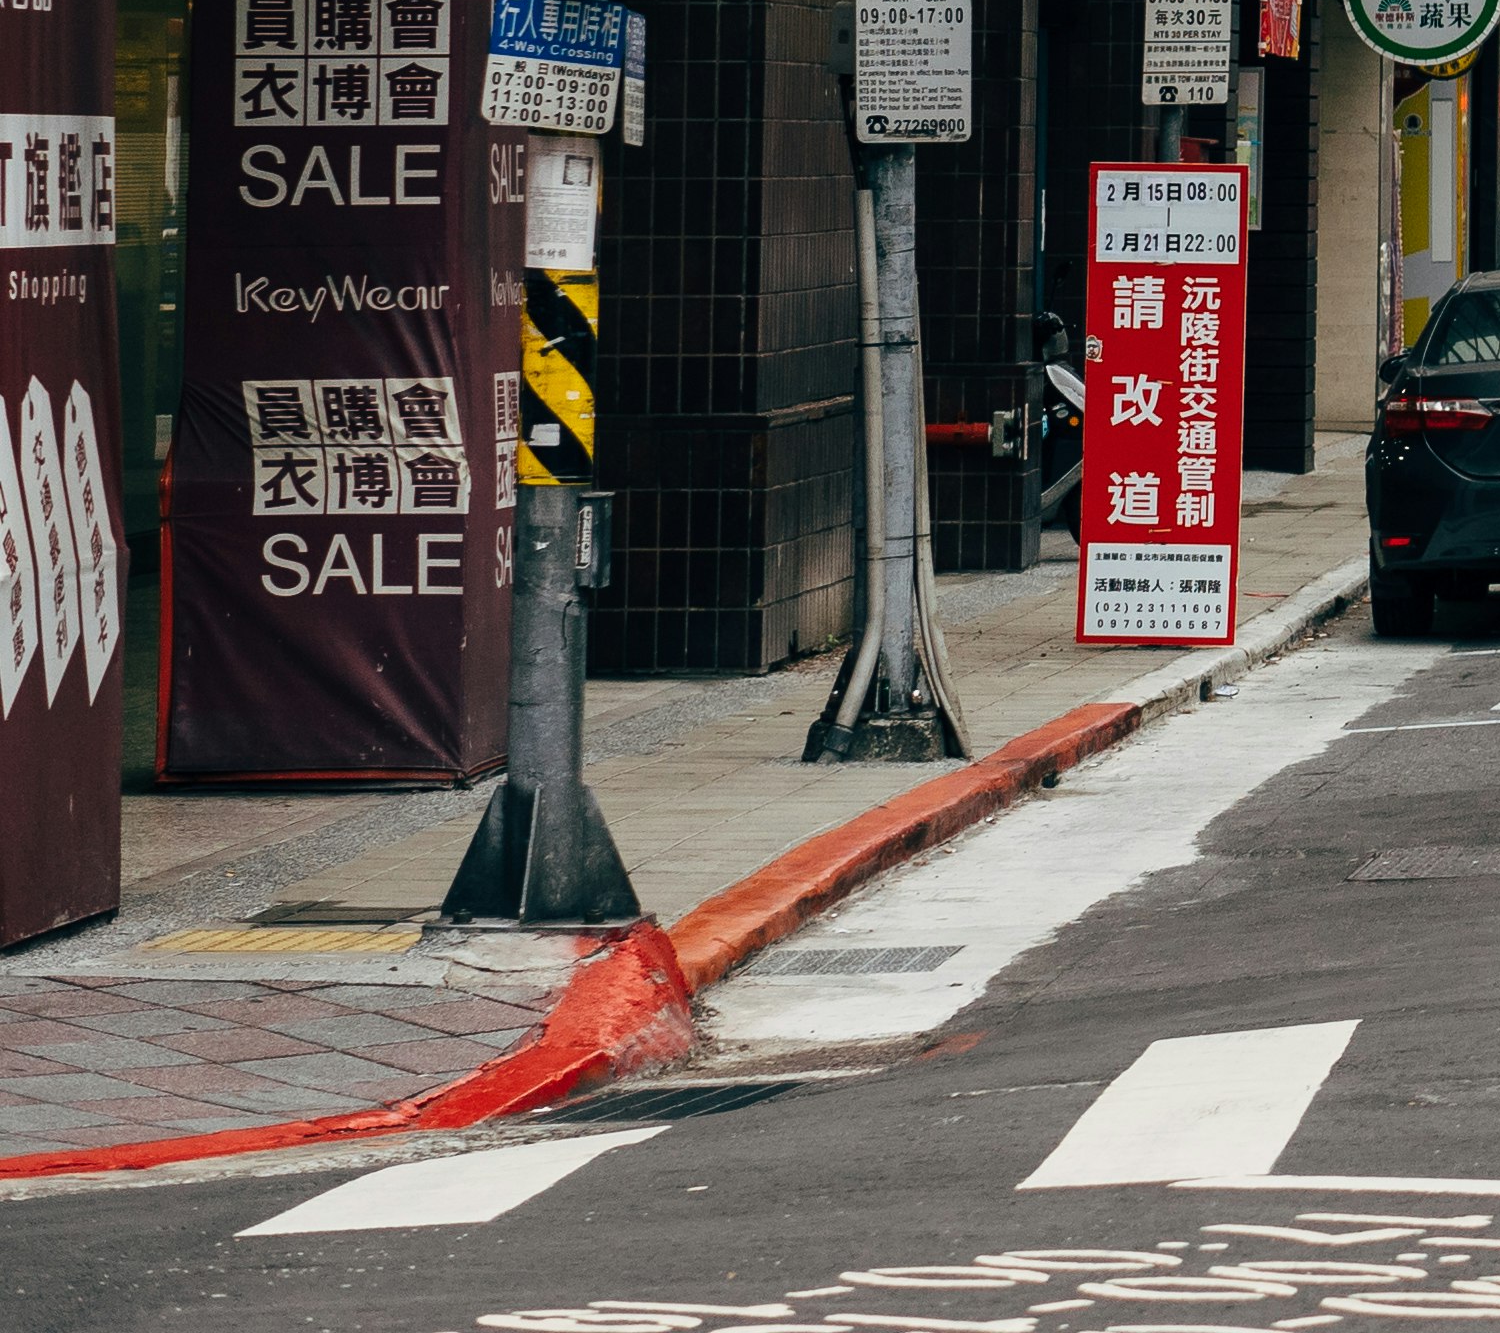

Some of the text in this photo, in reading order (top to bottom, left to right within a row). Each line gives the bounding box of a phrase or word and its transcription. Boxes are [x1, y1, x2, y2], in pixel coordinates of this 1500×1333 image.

[860, 8, 964, 24] 09:00-17:00
[1154, 9, 1222, 26] 每次30元
[1419, 3, 1472, 29] 蔬果
[1183, 30, 1221, 38] PER STAY
[498, 40, 614, 64] 4-Way Crossing
[492, 71, 610, 97] 07:00-09:00
[552, 64, 616, 82] (Workdays)
[239, 61, 448, 124] 衣博會
[490, 88, 608, 113] 11:00-13:00
[1188, 87, 1213, 101] 110
[488, 105, 606, 130] 17:00-19:00
[893, 118, 965, 134] 27269600
[241, 145, 441, 207] SALE
[490, 143, 525, 204] SALE
[9, 269, 87, 306] Shopping
[236, 273, 450, 324] KeyWear
[253, 382, 452, 443] 員購會
[1107, 275, 1165, 527] 請改道
[1175, 276, 1221, 528] 沅陵街交通管制
[260, 447, 469, 514] 衣博會
[262, 532, 464, 597] SALE
[1095, 602, 1222, 615] (02) 23111606
[1097, 619, 1221, 631] 0970306587
